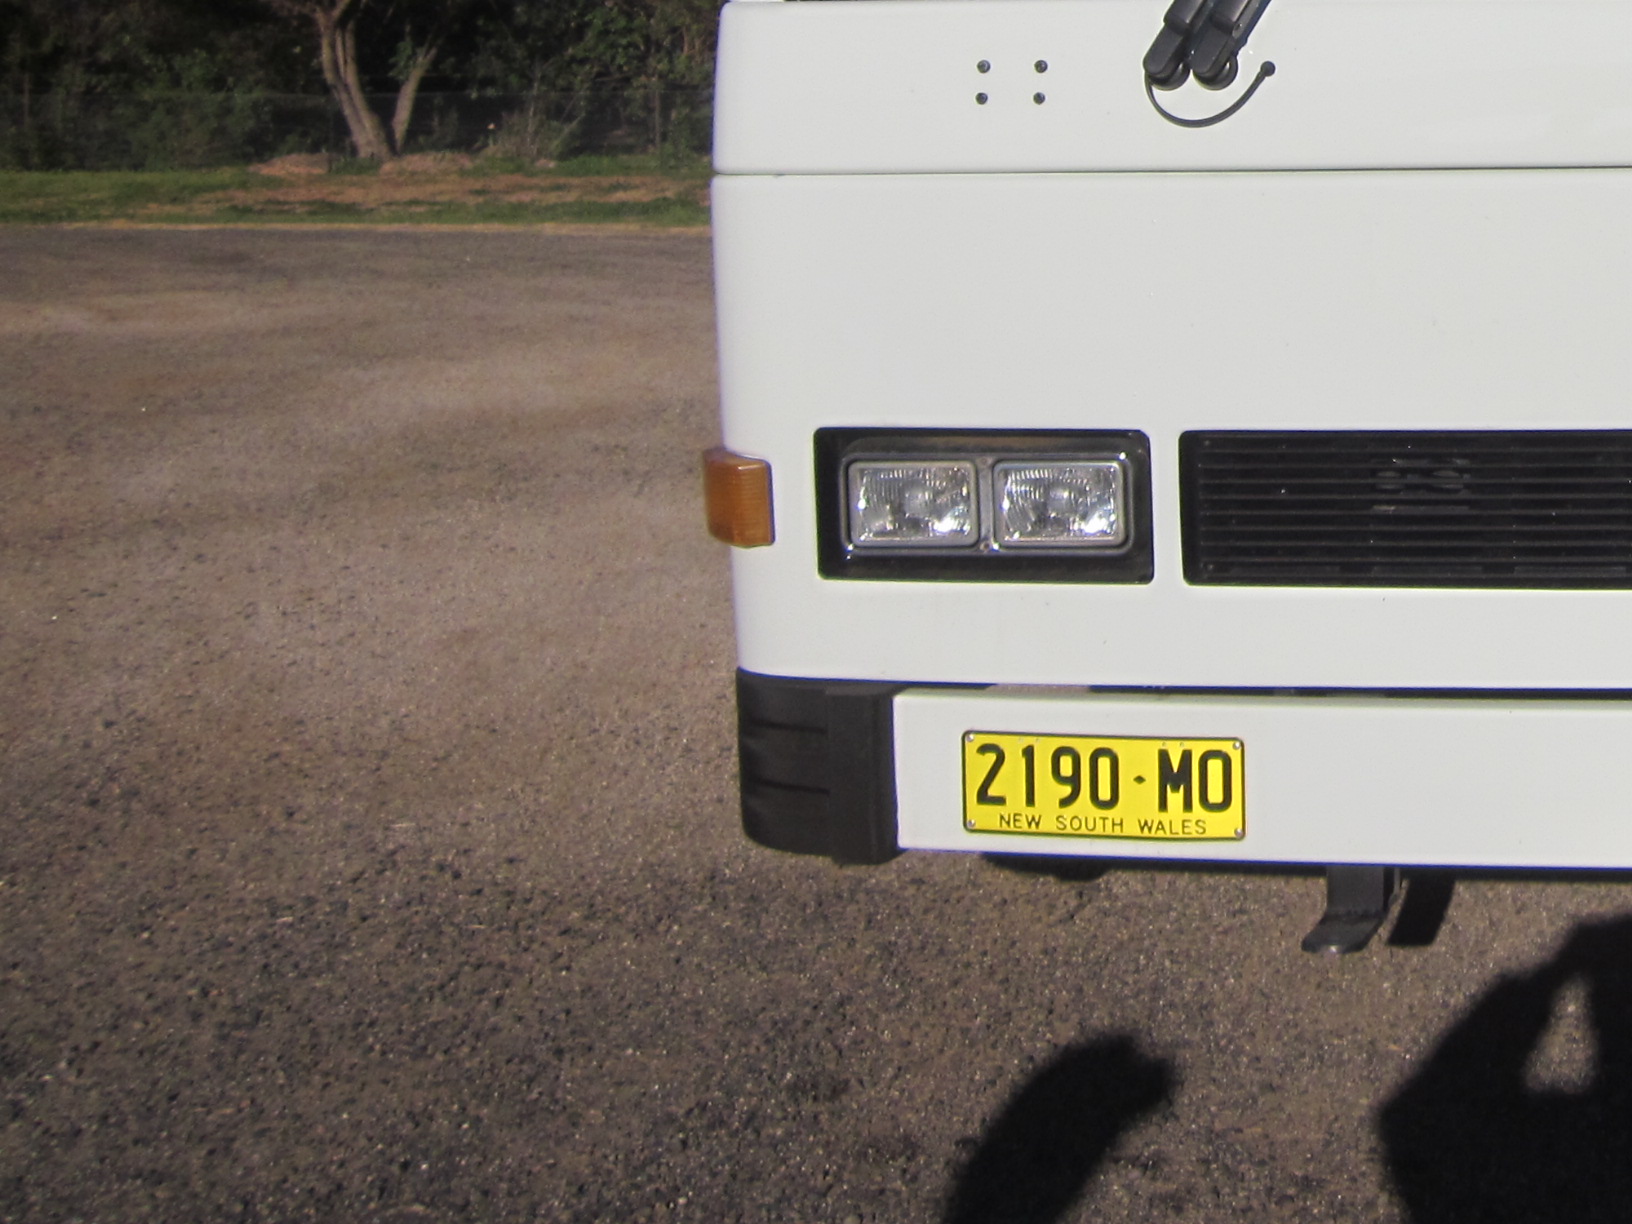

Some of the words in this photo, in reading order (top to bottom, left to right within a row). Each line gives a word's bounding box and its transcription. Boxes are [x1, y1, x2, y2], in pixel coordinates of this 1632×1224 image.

[998, 812, 1043, 830] NEW
[1055, 814, 1125, 834] SOUTH
[1138, 818, 1208, 836] WALES
